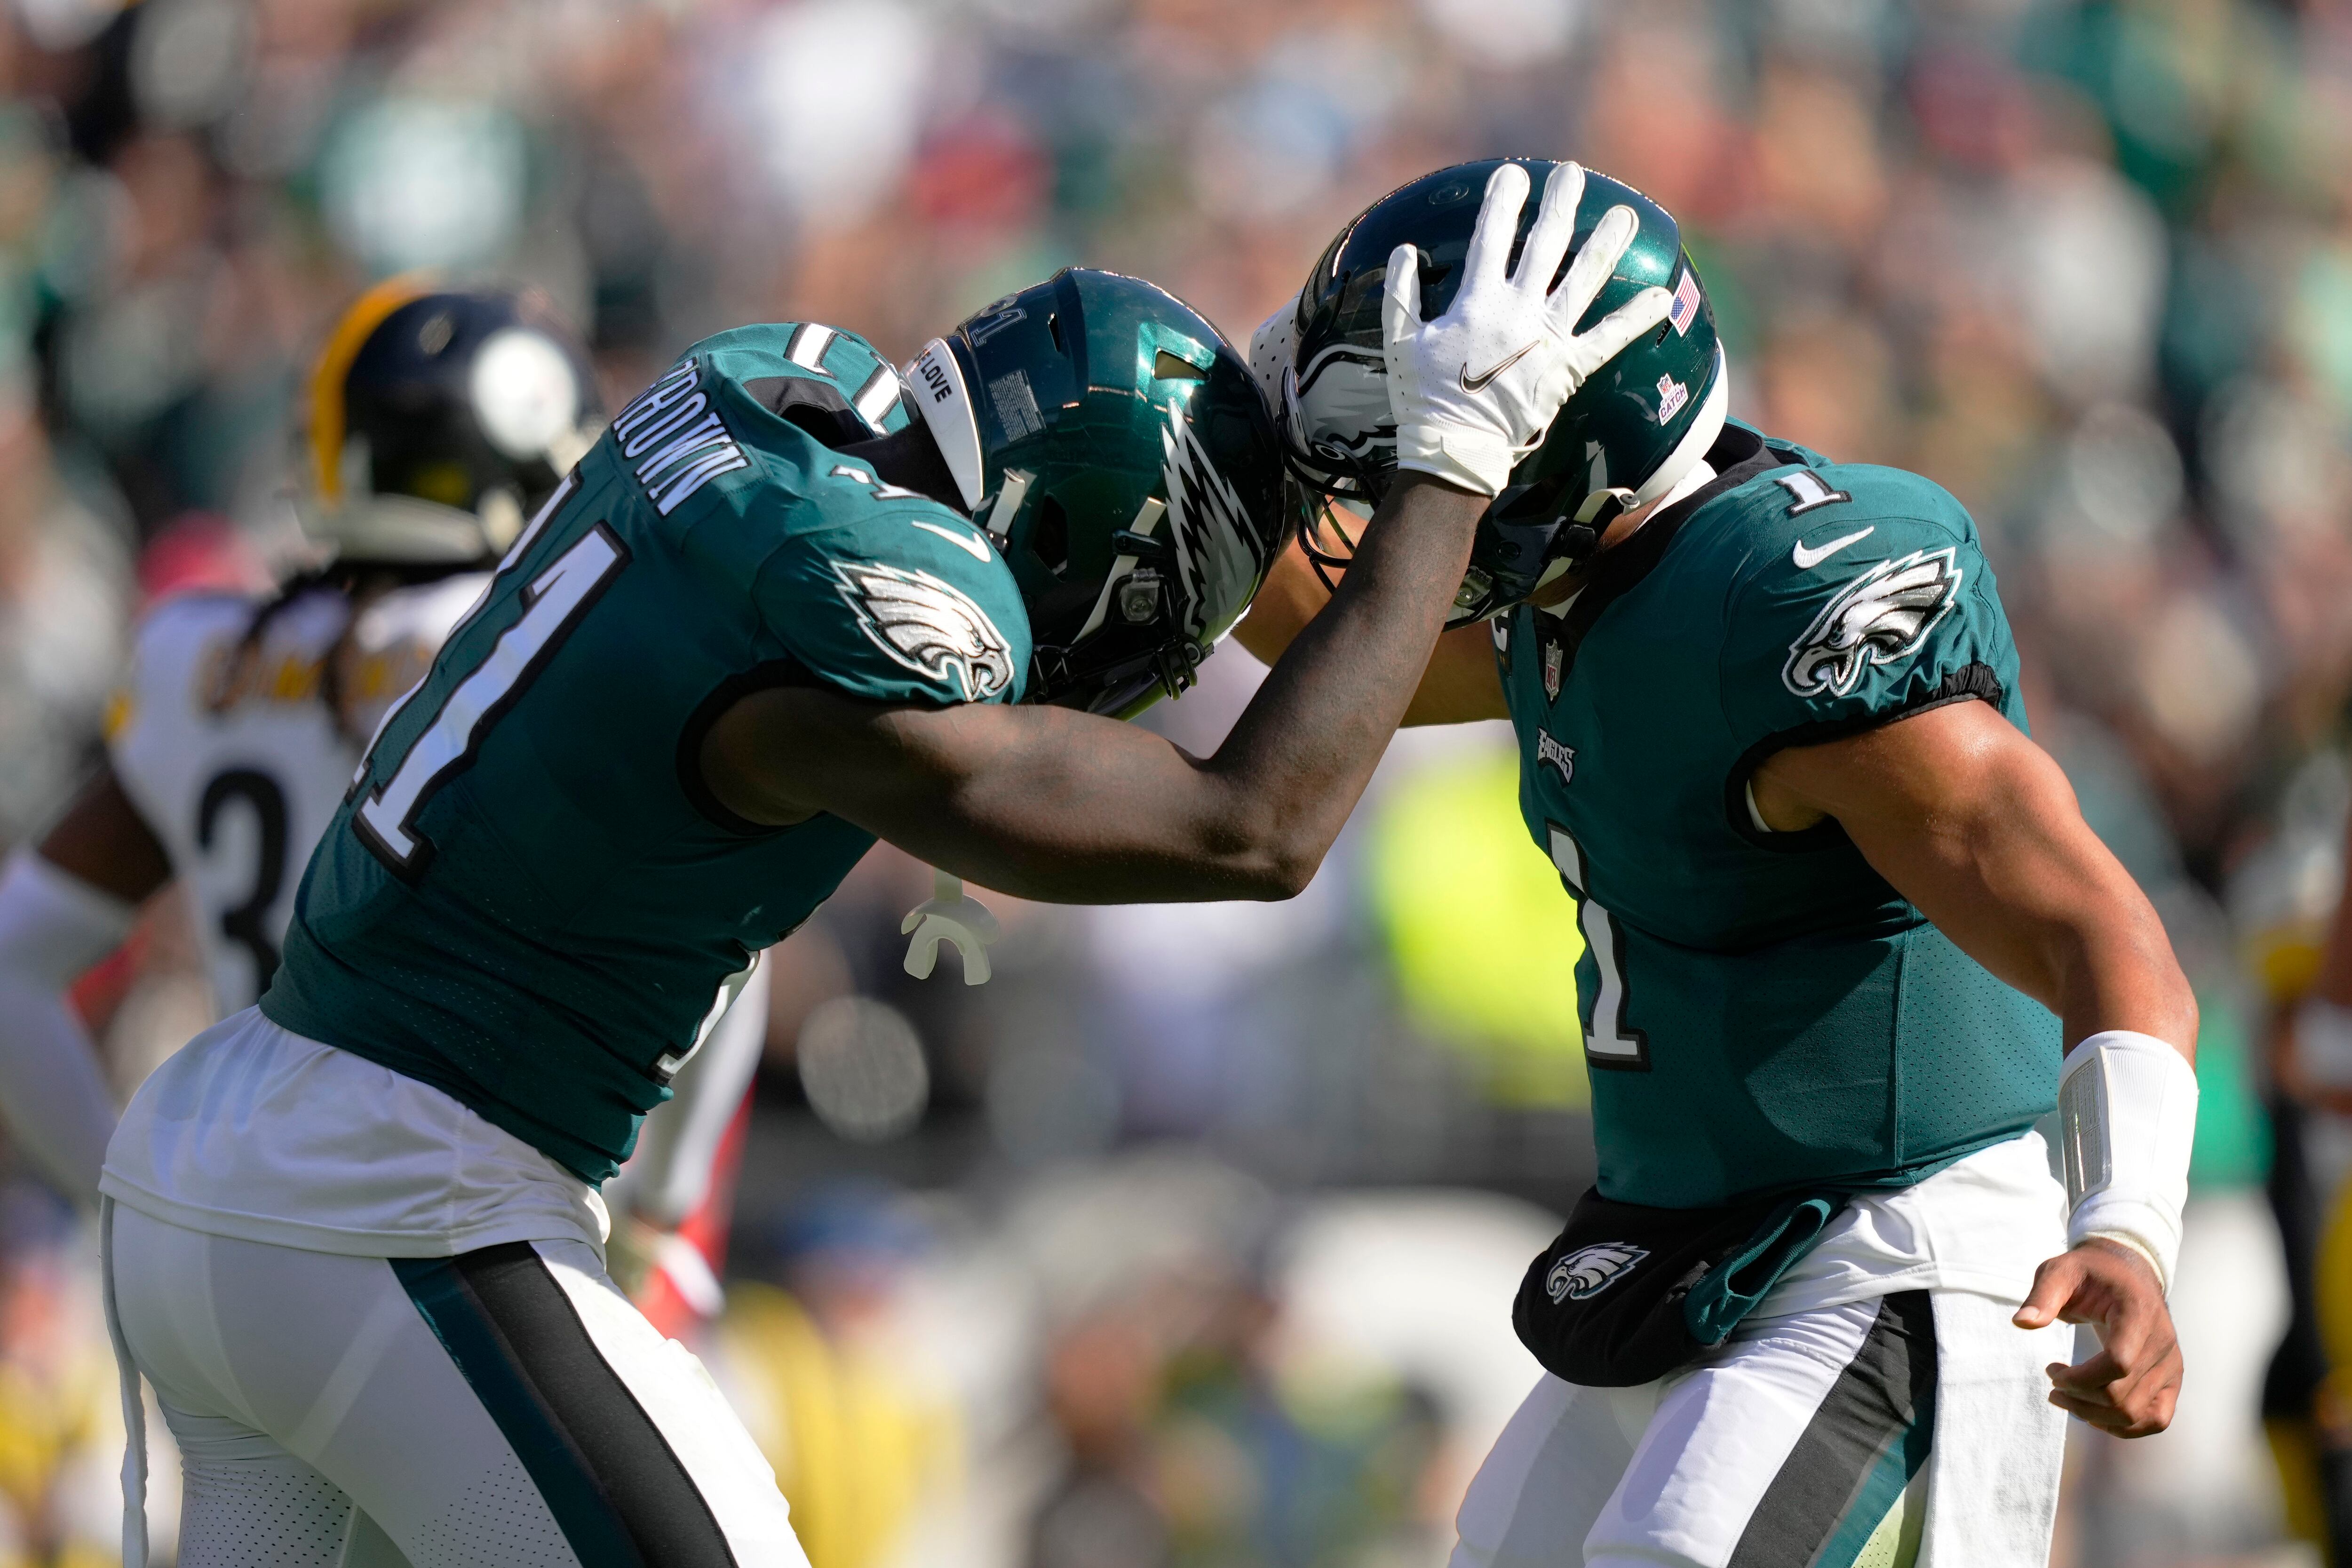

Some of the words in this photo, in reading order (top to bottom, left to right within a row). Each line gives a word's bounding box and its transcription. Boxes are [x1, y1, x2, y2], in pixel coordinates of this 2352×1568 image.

[970, 308, 1027, 347] 1
[920, 358, 953, 403] LOVE
[1662, 382, 1671, 393] NFL
[1662, 384, 1680, 406] CRUCIAL
[1661, 385, 1685, 418] CATCH
[1773, 470, 1852, 517] 1
[1547, 665, 1557, 689] NFL
[1537, 727, 1576, 784] EAGLES
[1546, 819, 1652, 1073] 1
